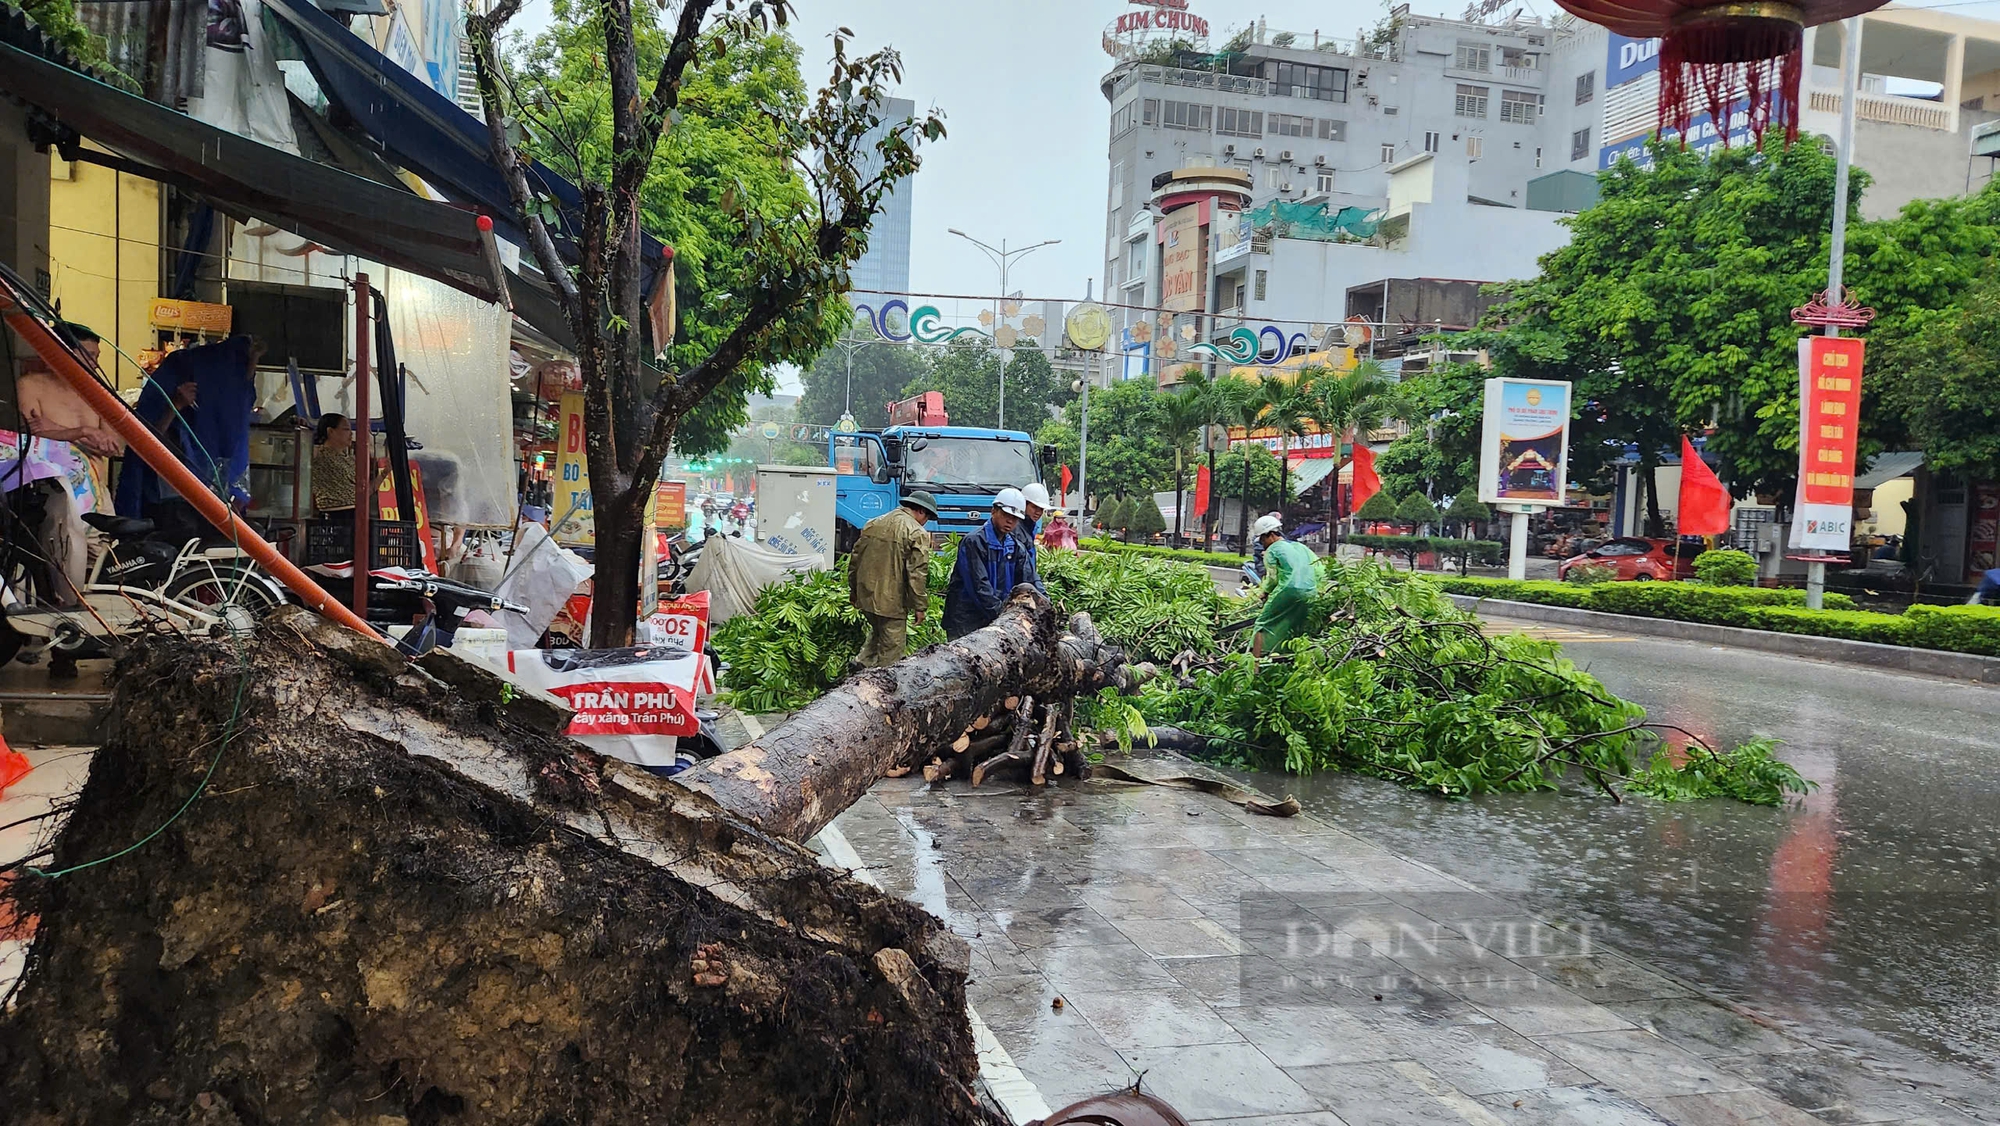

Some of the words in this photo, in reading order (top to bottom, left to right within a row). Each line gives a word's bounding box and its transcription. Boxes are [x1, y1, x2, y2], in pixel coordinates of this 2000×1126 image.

[1116, 11, 1149, 34] KIM
[1154, 10, 1209, 37] CHUNG
[563, 459, 580, 482] BÒ
[1820, 520, 1845, 533] ABIC
[106, 559, 138, 574] YAMAHA
[574, 686, 629, 709] TRẦN
[634, 688, 677, 710] PHÚ
[574, 711, 597, 726] cây
[598, 711, 629, 726] xăng
[631, 711, 659, 723] Trần
[660, 711, 685, 726] Phú)
